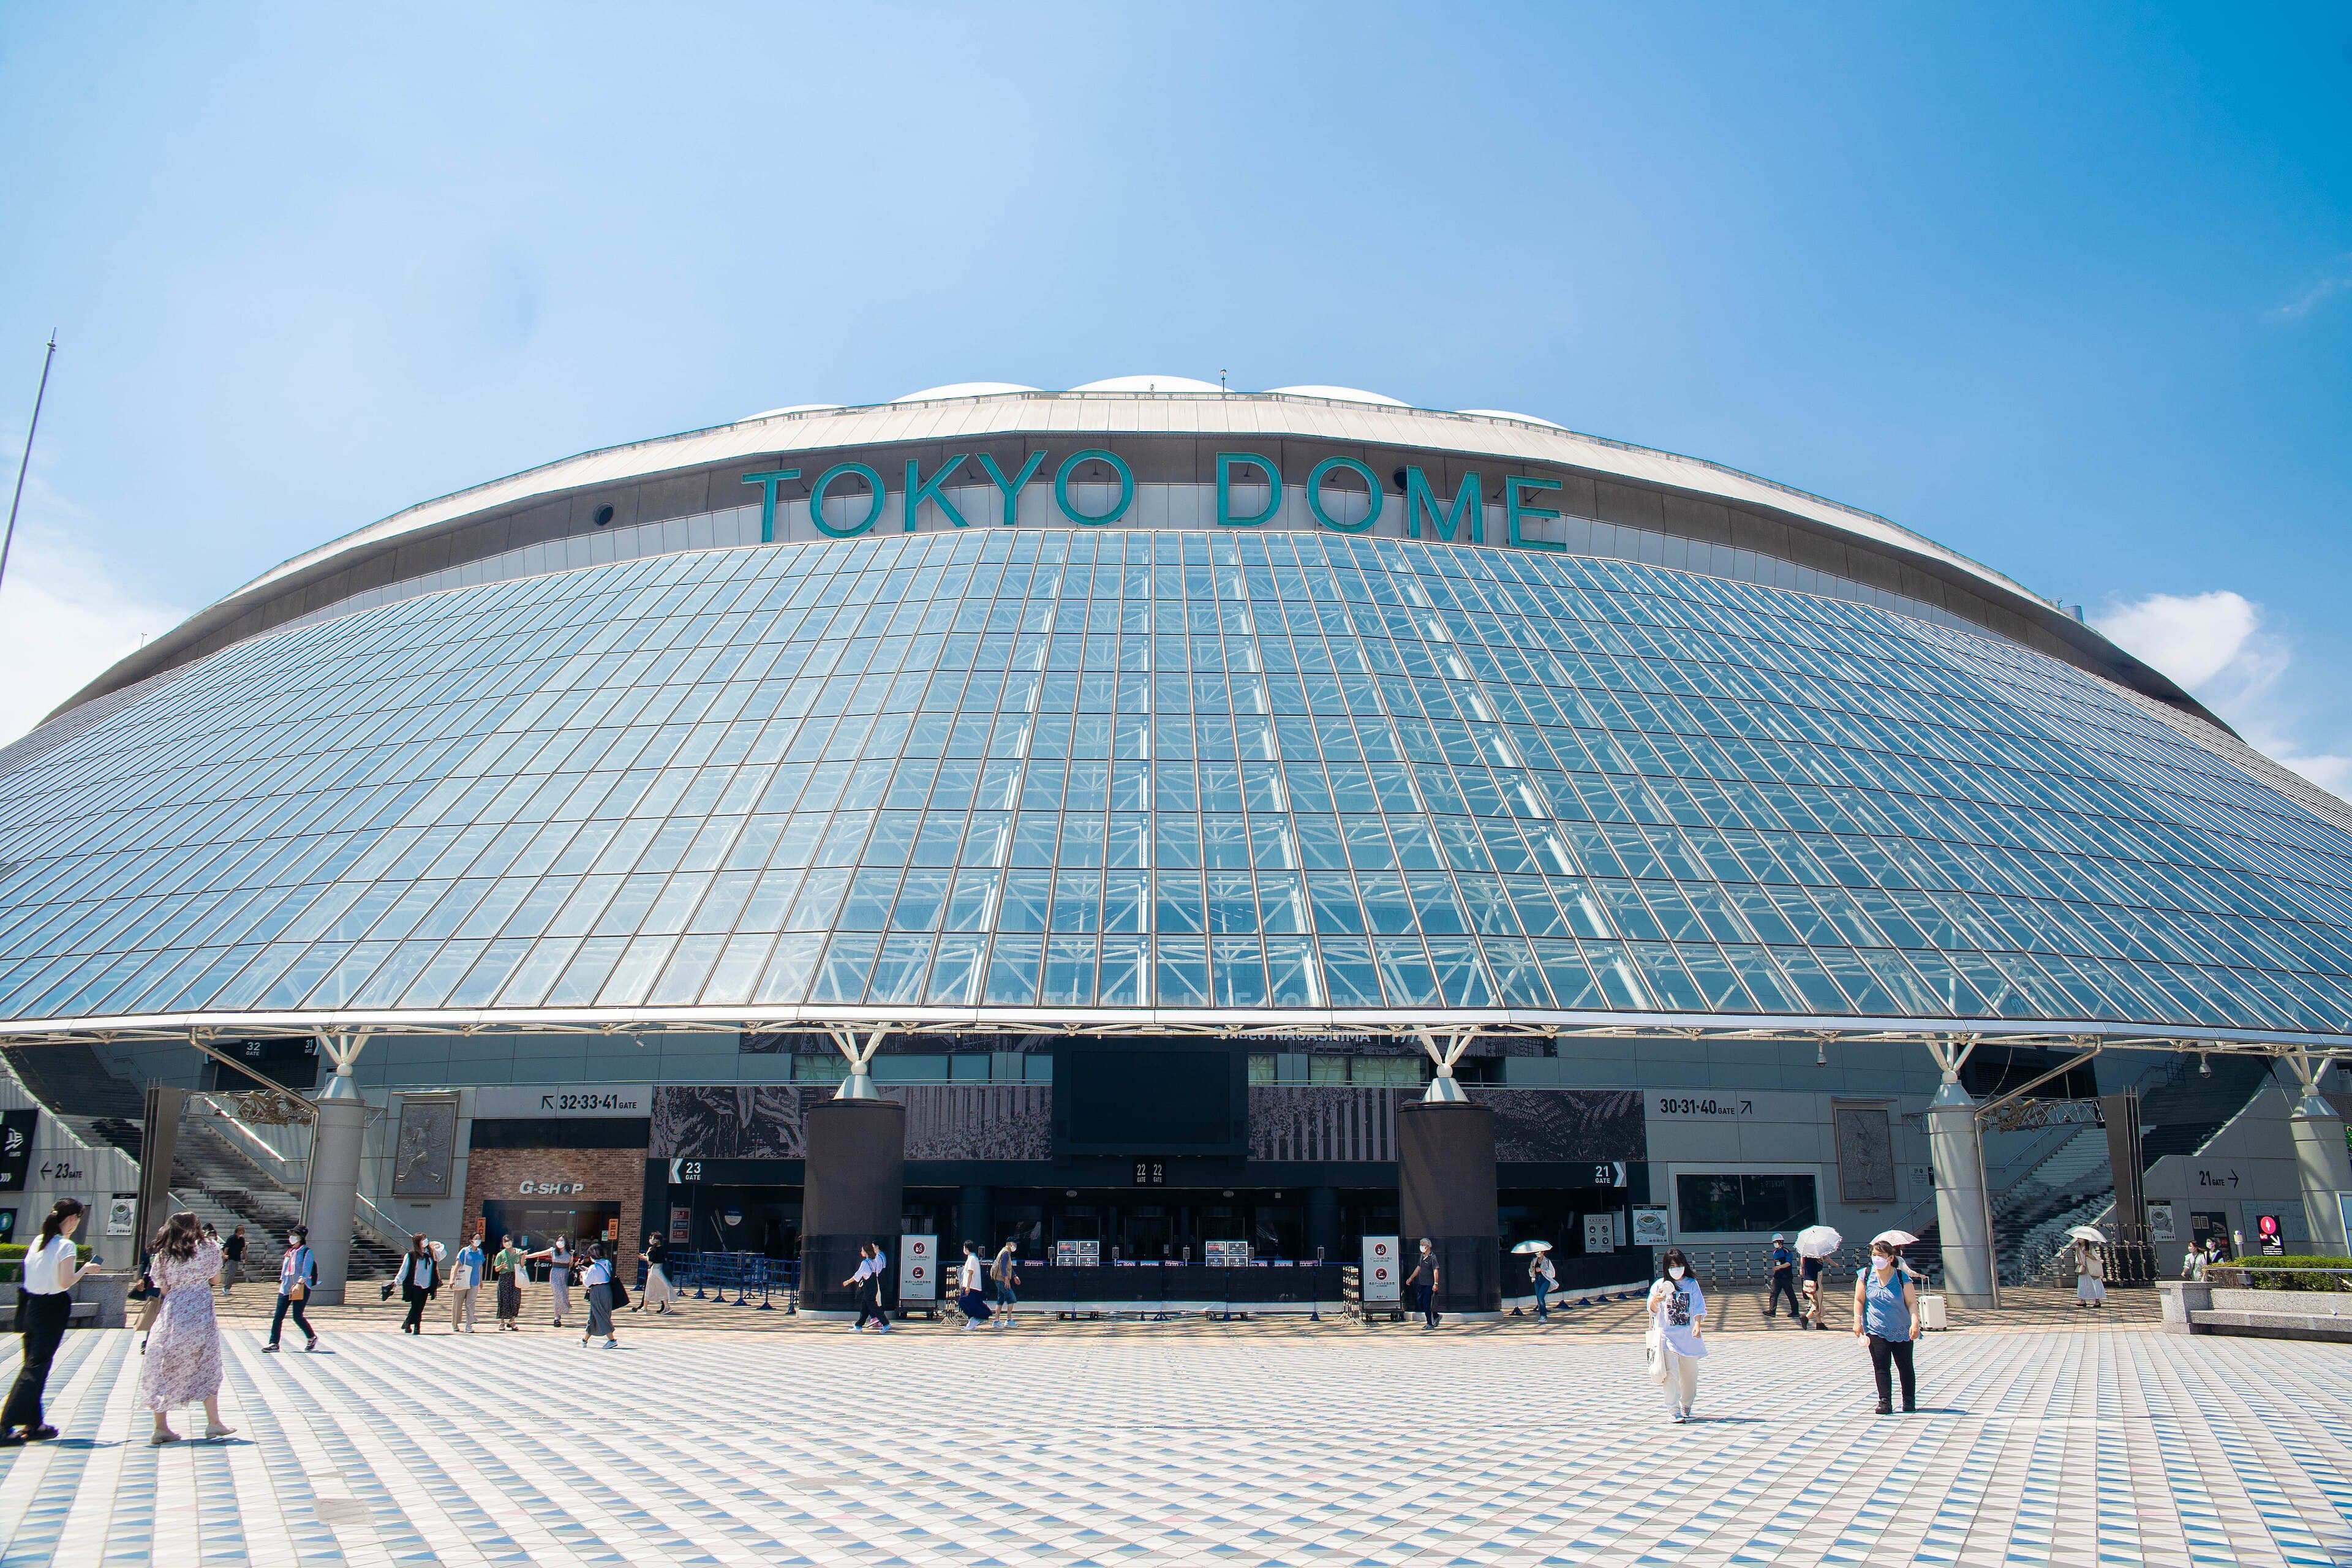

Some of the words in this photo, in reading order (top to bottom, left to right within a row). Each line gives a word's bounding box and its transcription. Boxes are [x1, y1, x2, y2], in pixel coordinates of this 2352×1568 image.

[742, 449, 1134, 543] TOKYO
[1216, 451, 1567, 552] DOME
[246, 1041, 260, 1051] 32
[306, 1039, 314, 1049] 31
[55, 1163, 69, 1178] 23
[686, 1162, 701, 1174] 23
[1137, 1164, 1145, 1175] 22
[1153, 1164, 1162, 1175] 22
[1595, 1166, 1608, 1177] 21
[2199, 1170, 2212, 1186] 21
[519, 1180, 585, 1194] G-SHOP
[610, 1223, 616, 1237] 出口
